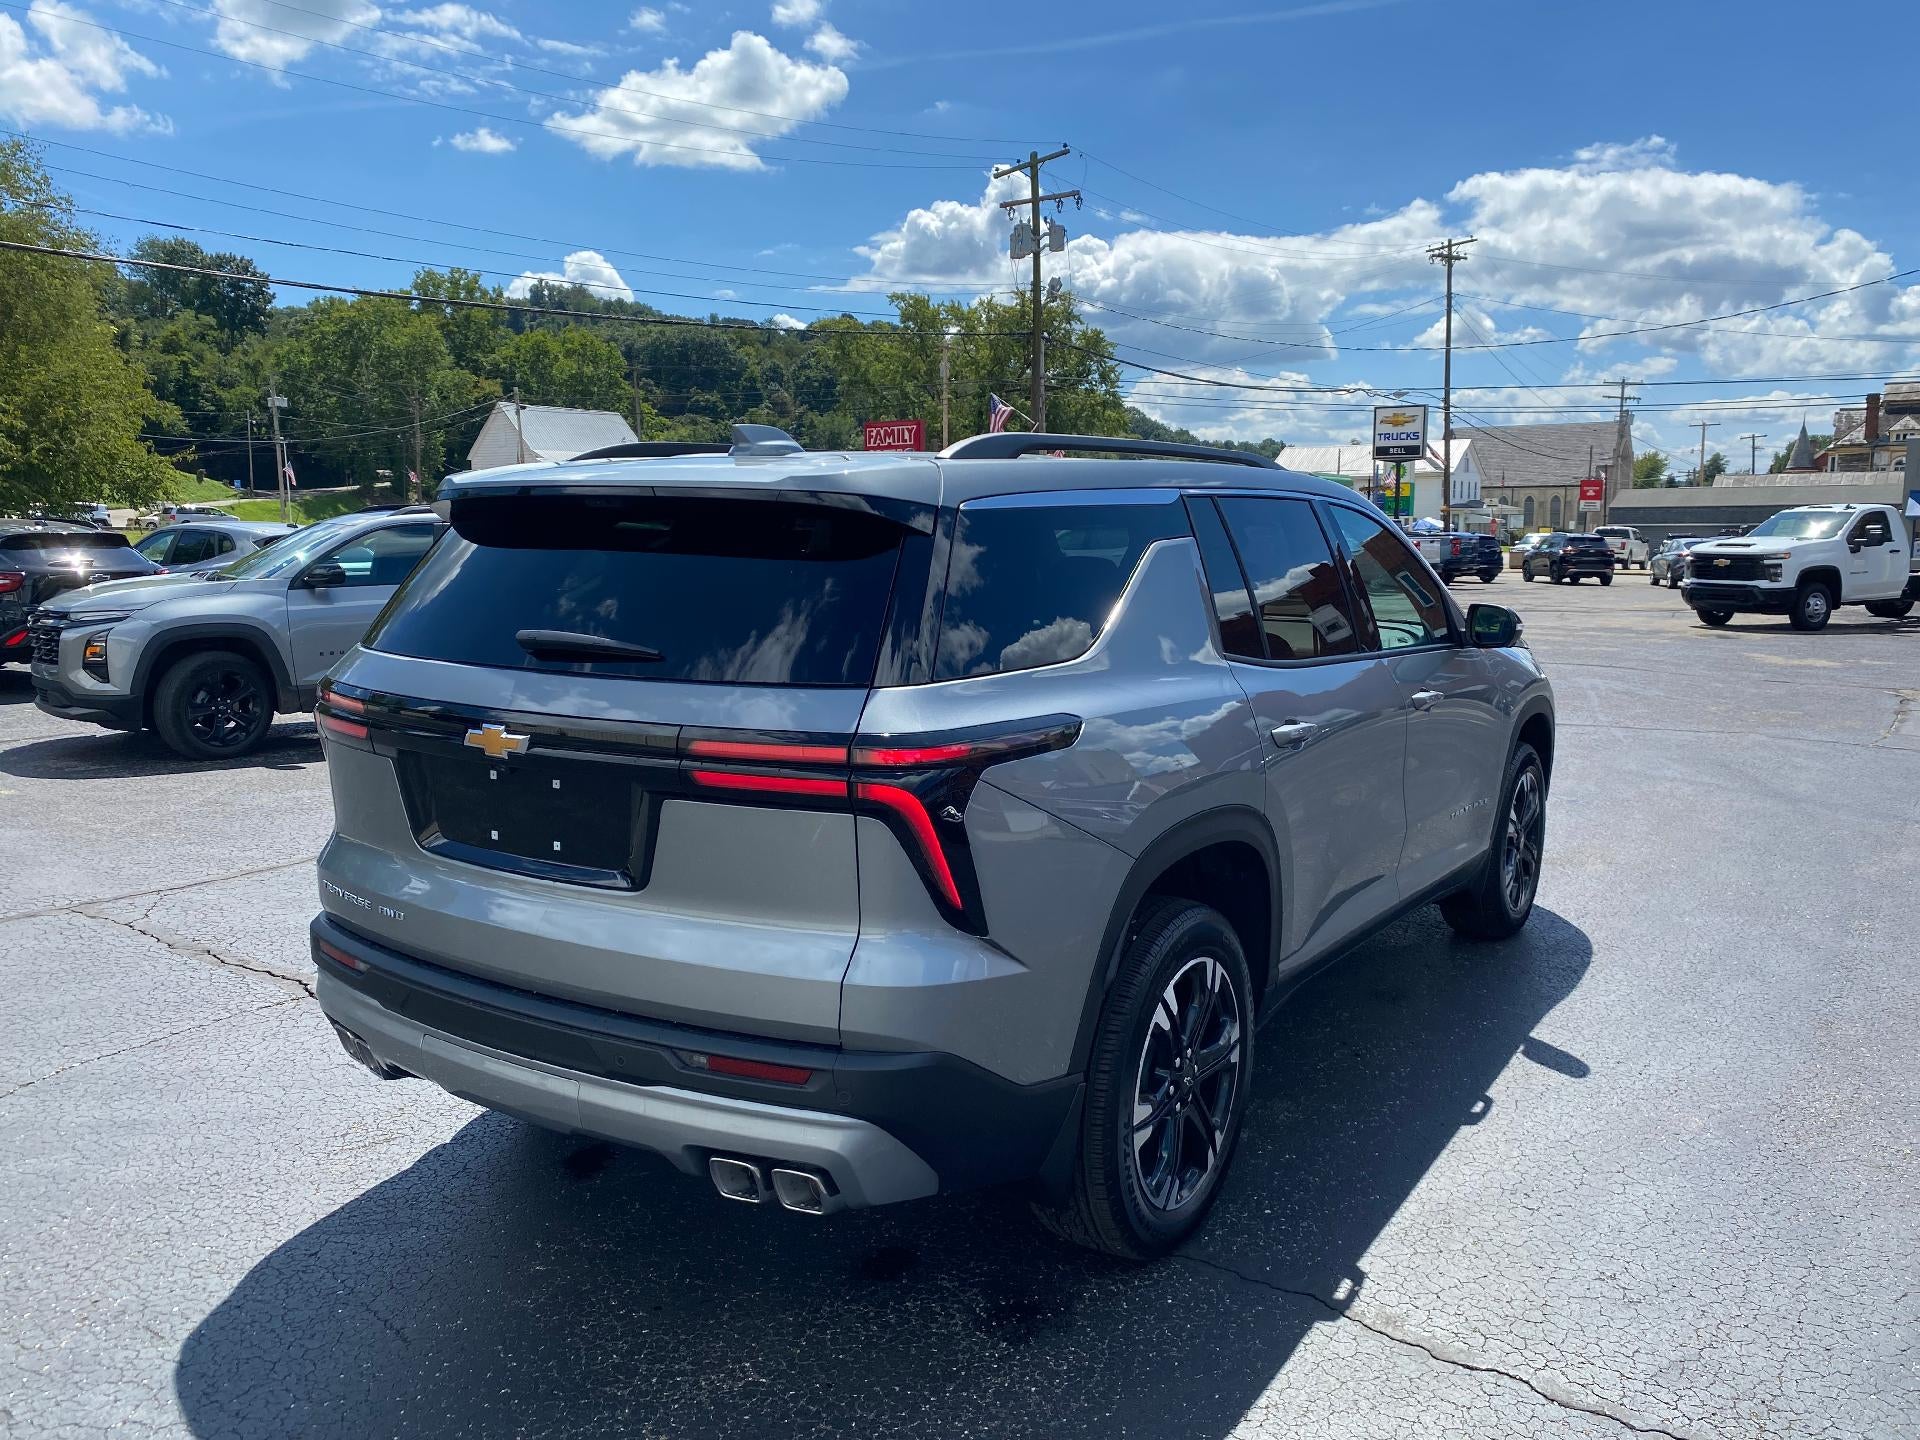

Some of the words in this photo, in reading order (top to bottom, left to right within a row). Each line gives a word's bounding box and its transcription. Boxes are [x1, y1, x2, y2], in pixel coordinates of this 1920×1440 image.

[866, 425, 916, 446] FAMILY
[1377, 431, 1420, 441] TRUCKS
[378, 905, 405, 921] AWD
